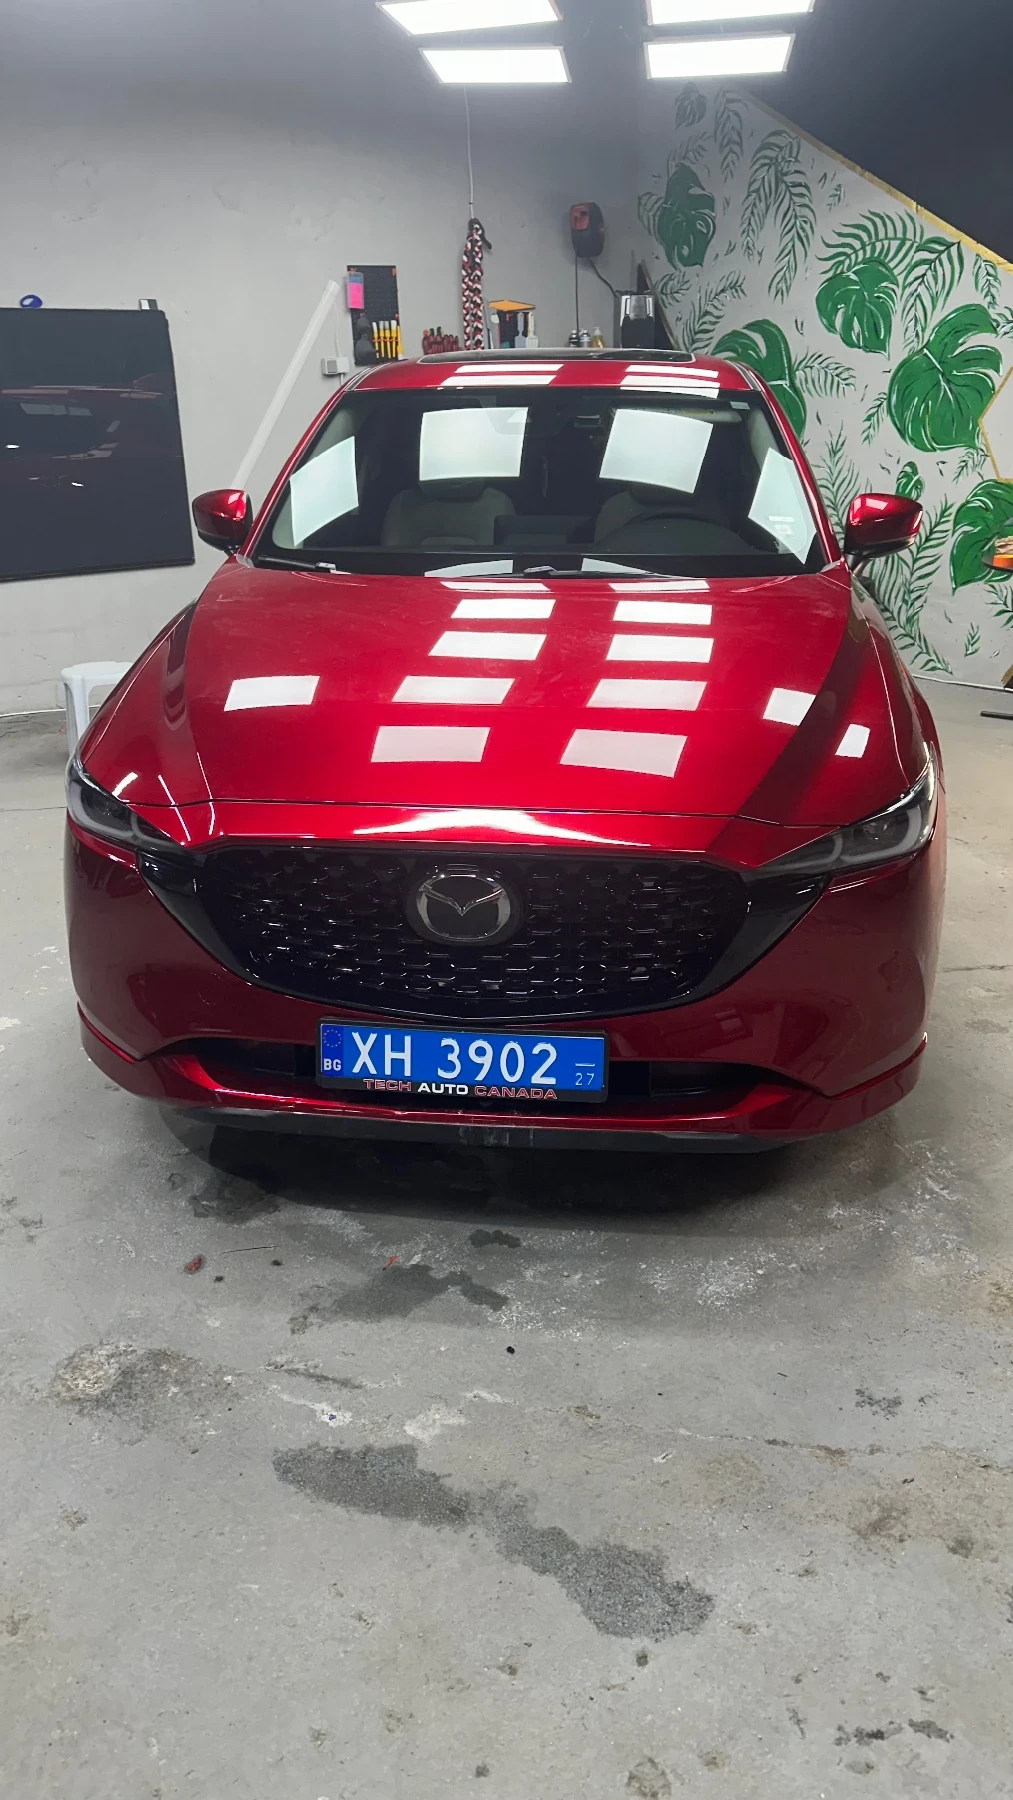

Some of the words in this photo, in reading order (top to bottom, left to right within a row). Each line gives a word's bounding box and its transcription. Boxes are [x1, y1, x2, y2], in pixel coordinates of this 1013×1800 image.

[323, 1058, 342, 1071] BG
[351, 1032, 412, 1077] XH
[437, 1038, 558, 1085] 3902
[575, 1073, 595, 1086] 27
[363, 1079, 412, 1092] TECH
[417, 1082, 468, 1095] AUTO
[474, 1085, 558, 1100] CANADA
